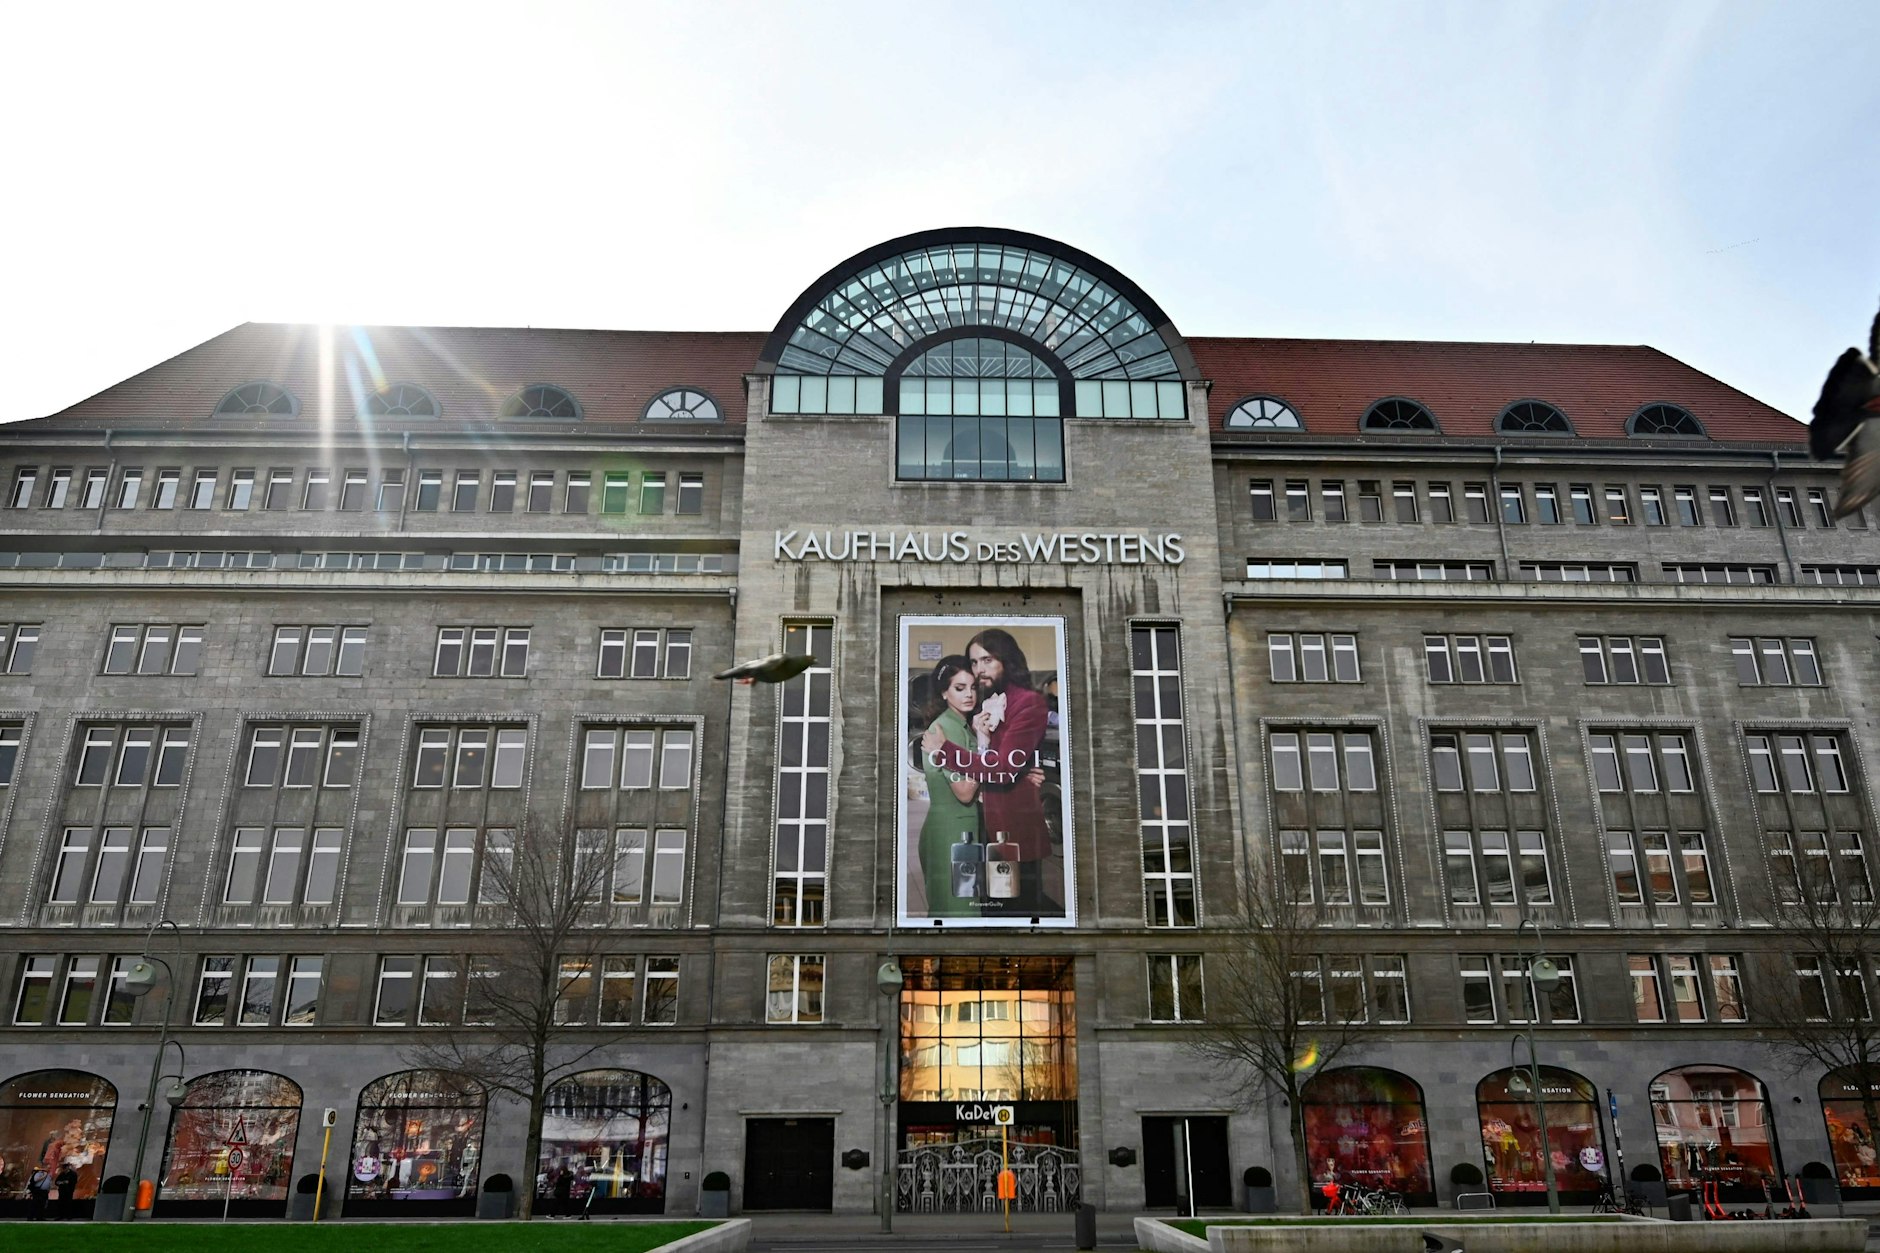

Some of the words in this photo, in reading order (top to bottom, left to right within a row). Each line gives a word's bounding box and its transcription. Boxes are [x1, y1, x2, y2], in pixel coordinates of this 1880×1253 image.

[774, 530, 970, 562] KAUFHAUS
[977, 542, 1021, 562] DES
[1021, 533, 1185, 563] WESTENS
[928, 749, 1040, 768] GUCCI
[950, 772, 1018, 783] GUILTY
[230, 1153, 240, 1164] 30
